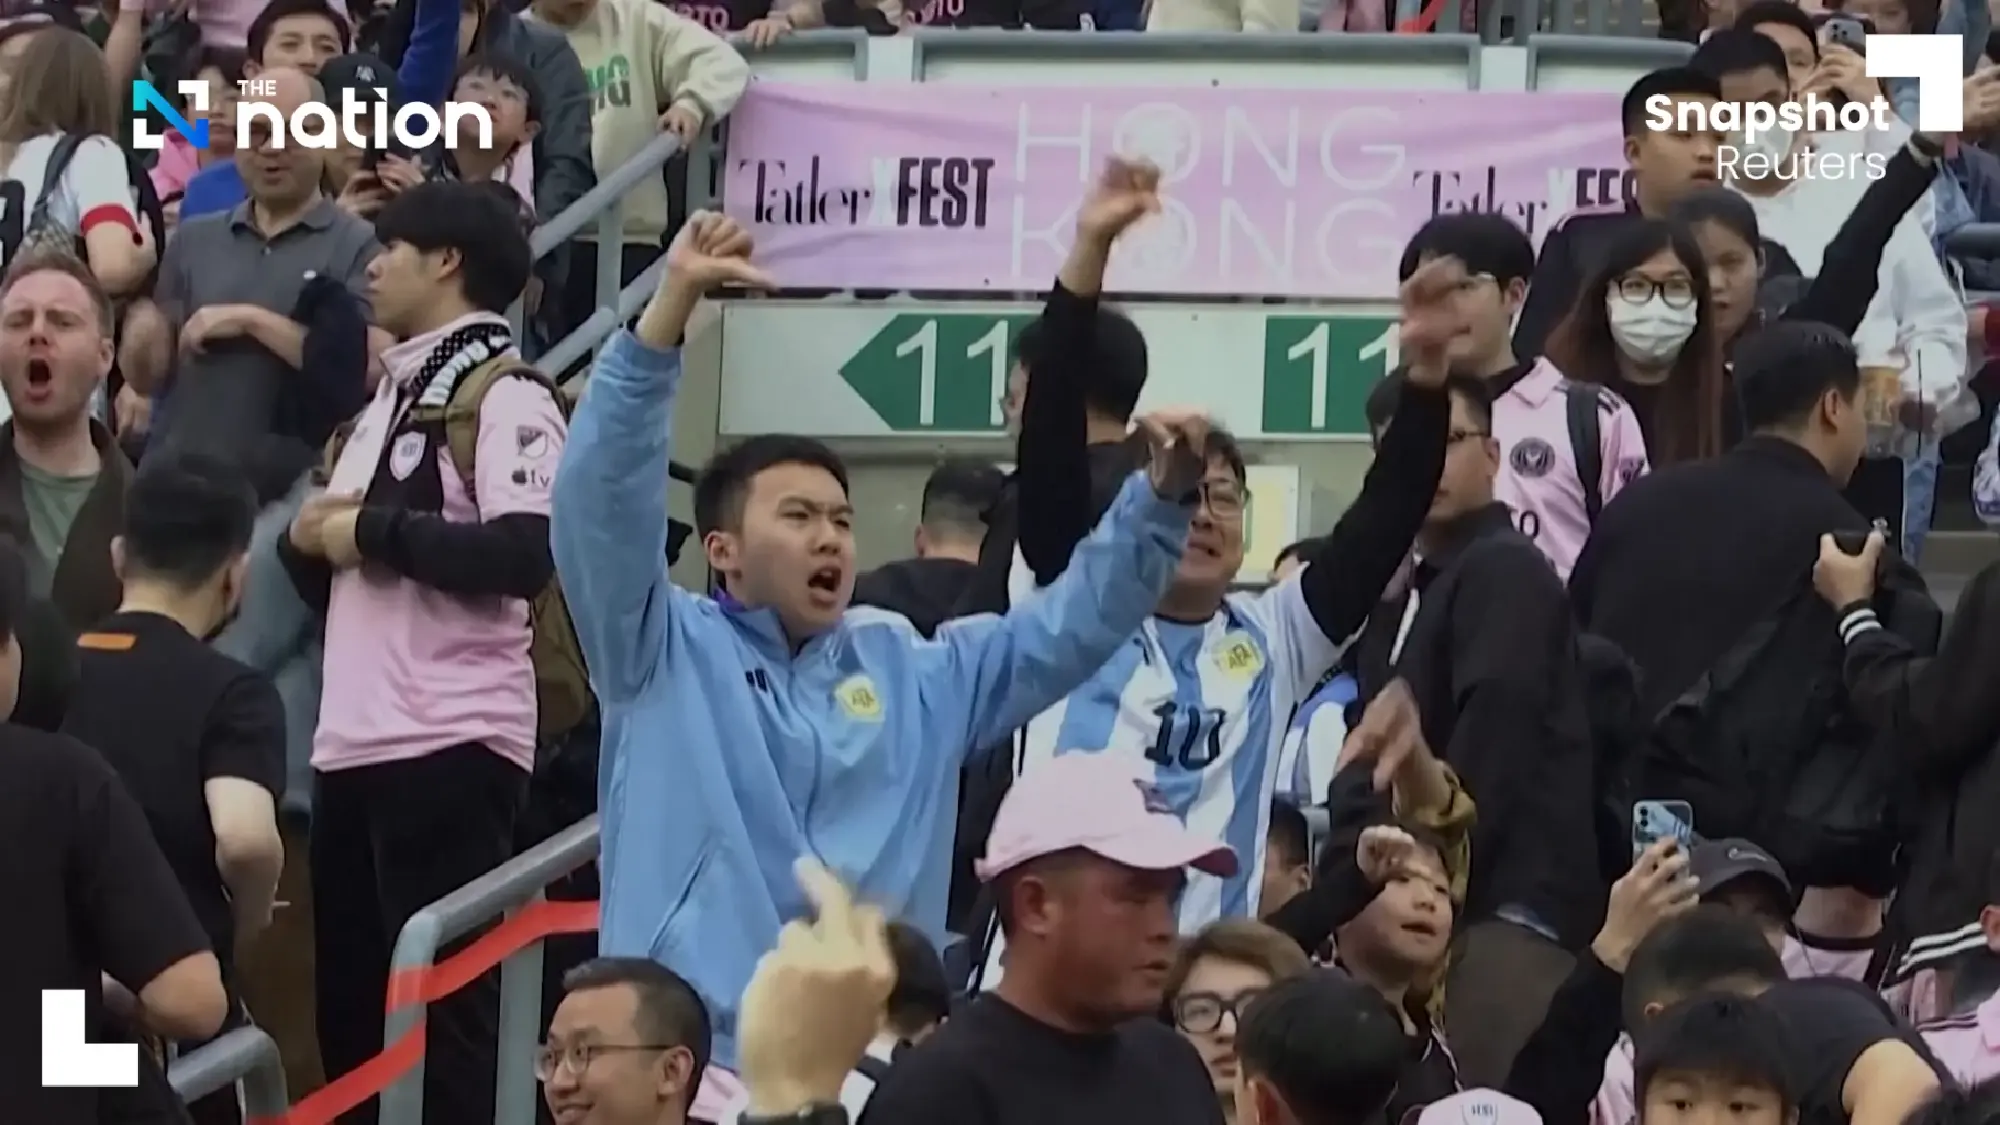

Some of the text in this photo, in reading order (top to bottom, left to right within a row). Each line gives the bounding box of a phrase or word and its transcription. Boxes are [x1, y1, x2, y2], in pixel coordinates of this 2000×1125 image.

[738, 155, 870, 225] Tatler
[1015, 101, 1406, 190] HONG
[1011, 193, 1402, 287] KONG
[896, 319, 1009, 426] 11
[1288, 321, 1400, 428] 11
[1144, 701, 1227, 771] 10
